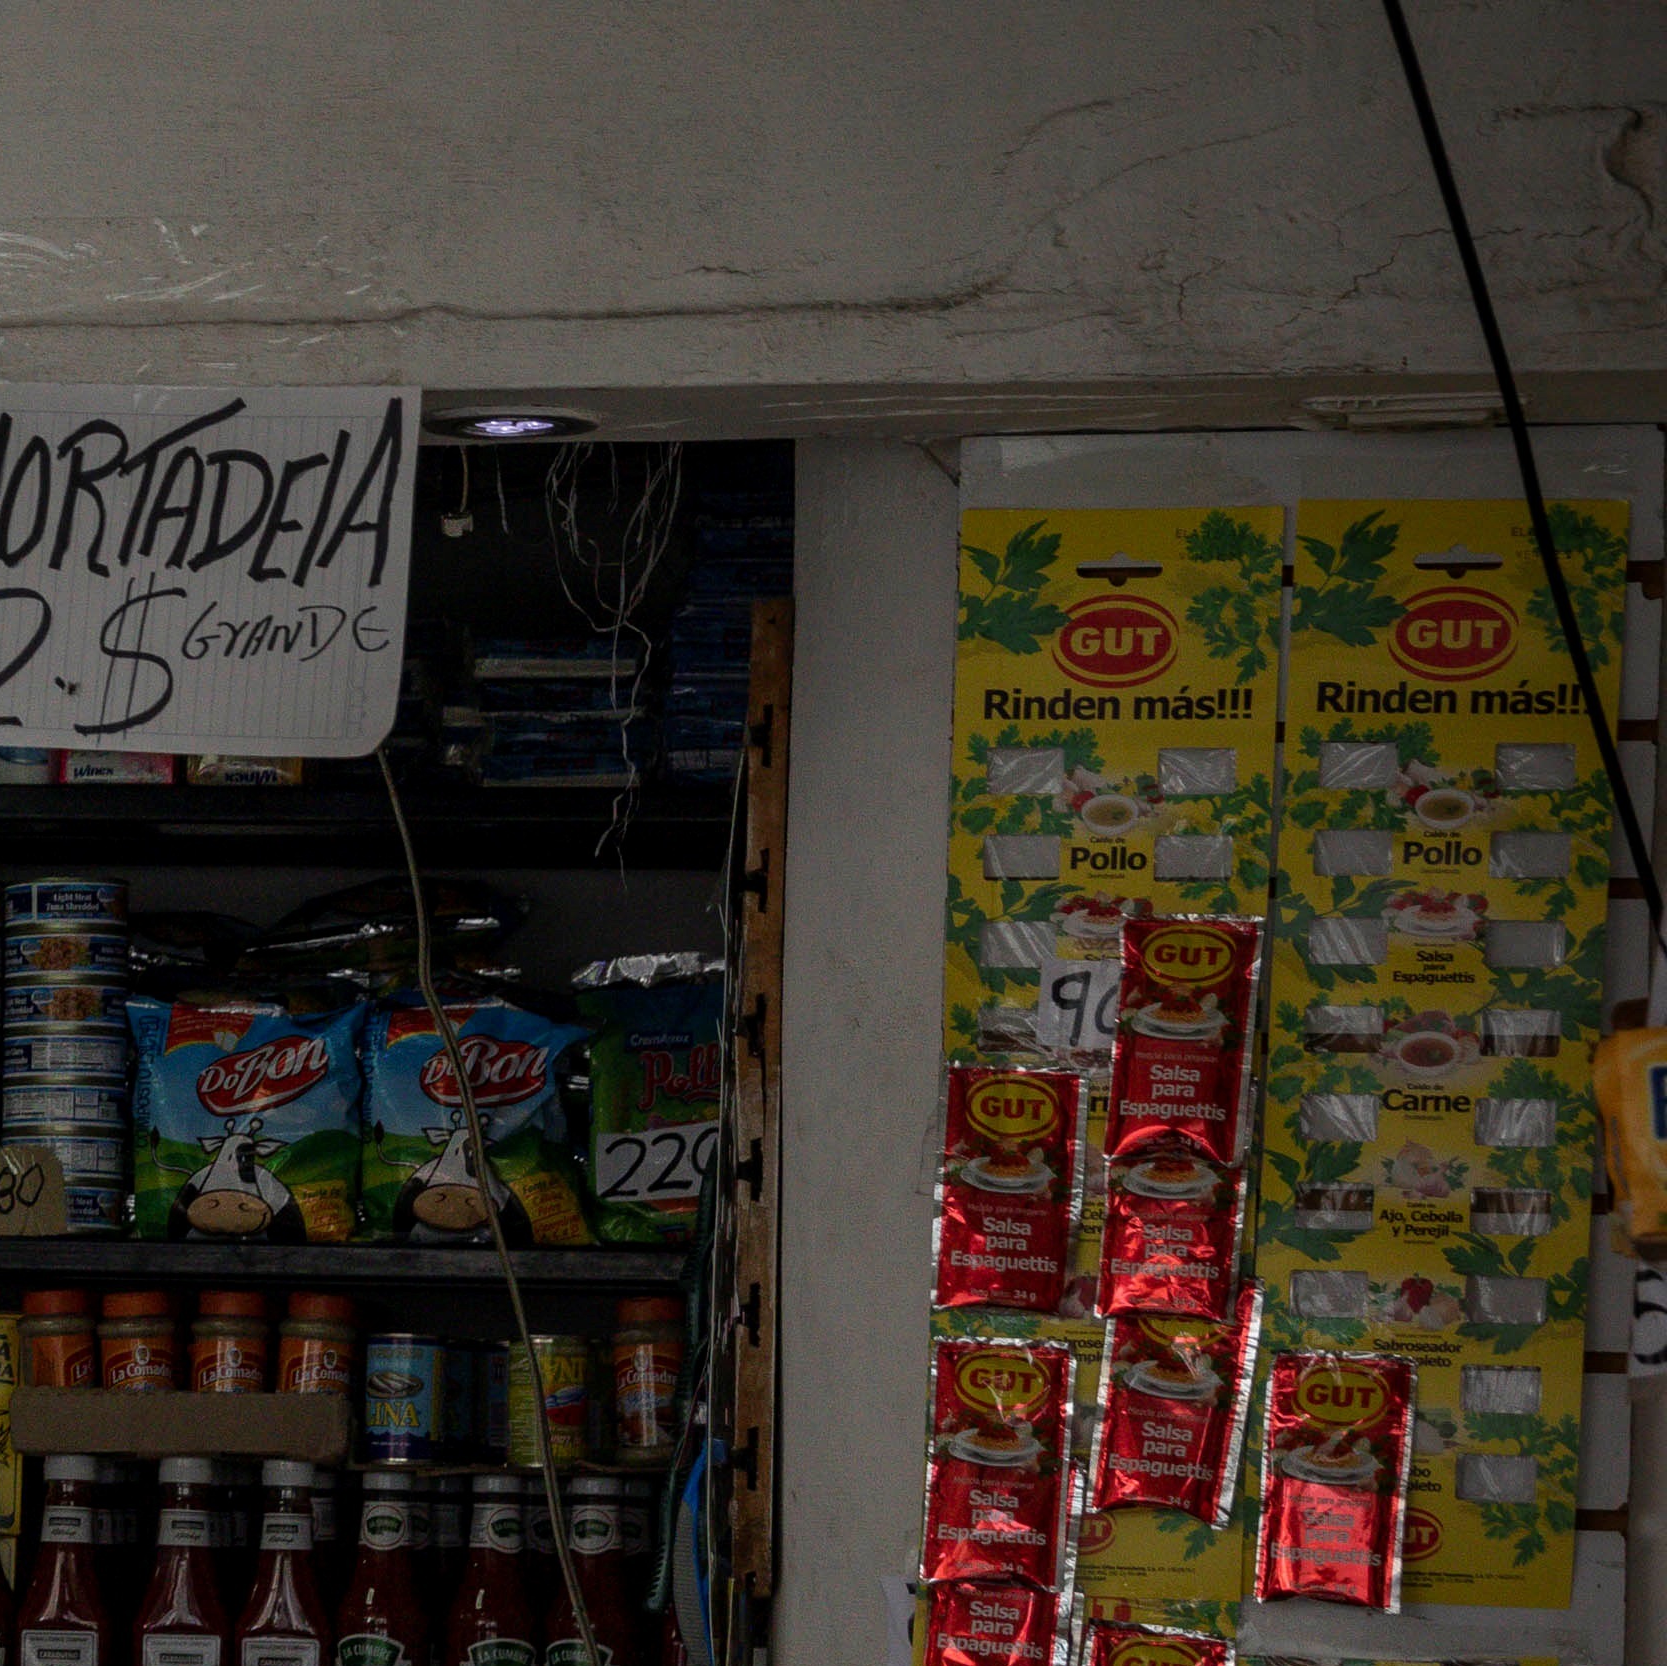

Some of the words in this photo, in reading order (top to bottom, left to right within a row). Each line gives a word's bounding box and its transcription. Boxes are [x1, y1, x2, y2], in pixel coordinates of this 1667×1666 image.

[1068, 625, 1164, 659] GUT
[1405, 615, 1504, 653] GUT
[982, 688, 1122, 722] Rinden
[1134, 688, 1254, 722] más!!!
[1316, 681, 1458, 715] Rinden
[1068, 845, 1148, 872] Pollo
[1401, 840, 1483, 867] Pollo
[1154, 944, 1224, 966] GUT
[1416, 950, 1454, 963] Salsa
[1392, 971, 1476, 985] Espaguettis
[1149, 1064, 1202, 1083] Salsa
[1151, 1081, 1196, 1100] para
[1382, 1088, 1471, 1113] Carne
[979, 1098, 1045, 1121] GUT
[1118, 1099, 1227, 1123] Espaguettis
[982, 1216, 1033, 1236] Salsa
[1378, 1208, 1406, 1225] Ajo,
[1410, 1209, 1464, 1224] Cebolla
[1142, 1224, 1194, 1242] Salsa
[1391, 1225, 1402, 1238] y
[1404, 1223, 1450, 1239] Perejil
[984, 1234, 1028, 1253] para
[1143, 1241, 1189, 1260] para
[949, 1251, 1059, 1275] Espaguettis
[1110, 1260, 1220, 1279] Espaguettis
[1372, 1338, 1463, 1354] Sabroseador
[112, 1368, 126, 1386] La
[202, 1367, 217, 1386] La
[968, 1367, 1039, 1394] GUT
[1306, 1383, 1377, 1409] GUT
[1141, 1421, 1195, 1442] Salsa
[1143, 1439, 1188, 1460] para
[1108, 1453, 1215, 1483] Espaguettis
[968, 1489, 1021, 1509] Salsa
[937, 1523, 1048, 1548] Espaguettis
[968, 1601, 1020, 1621] Salsa
[970, 1619, 1015, 1639] para
[936, 1635, 1044, 1662] Espaguettis
